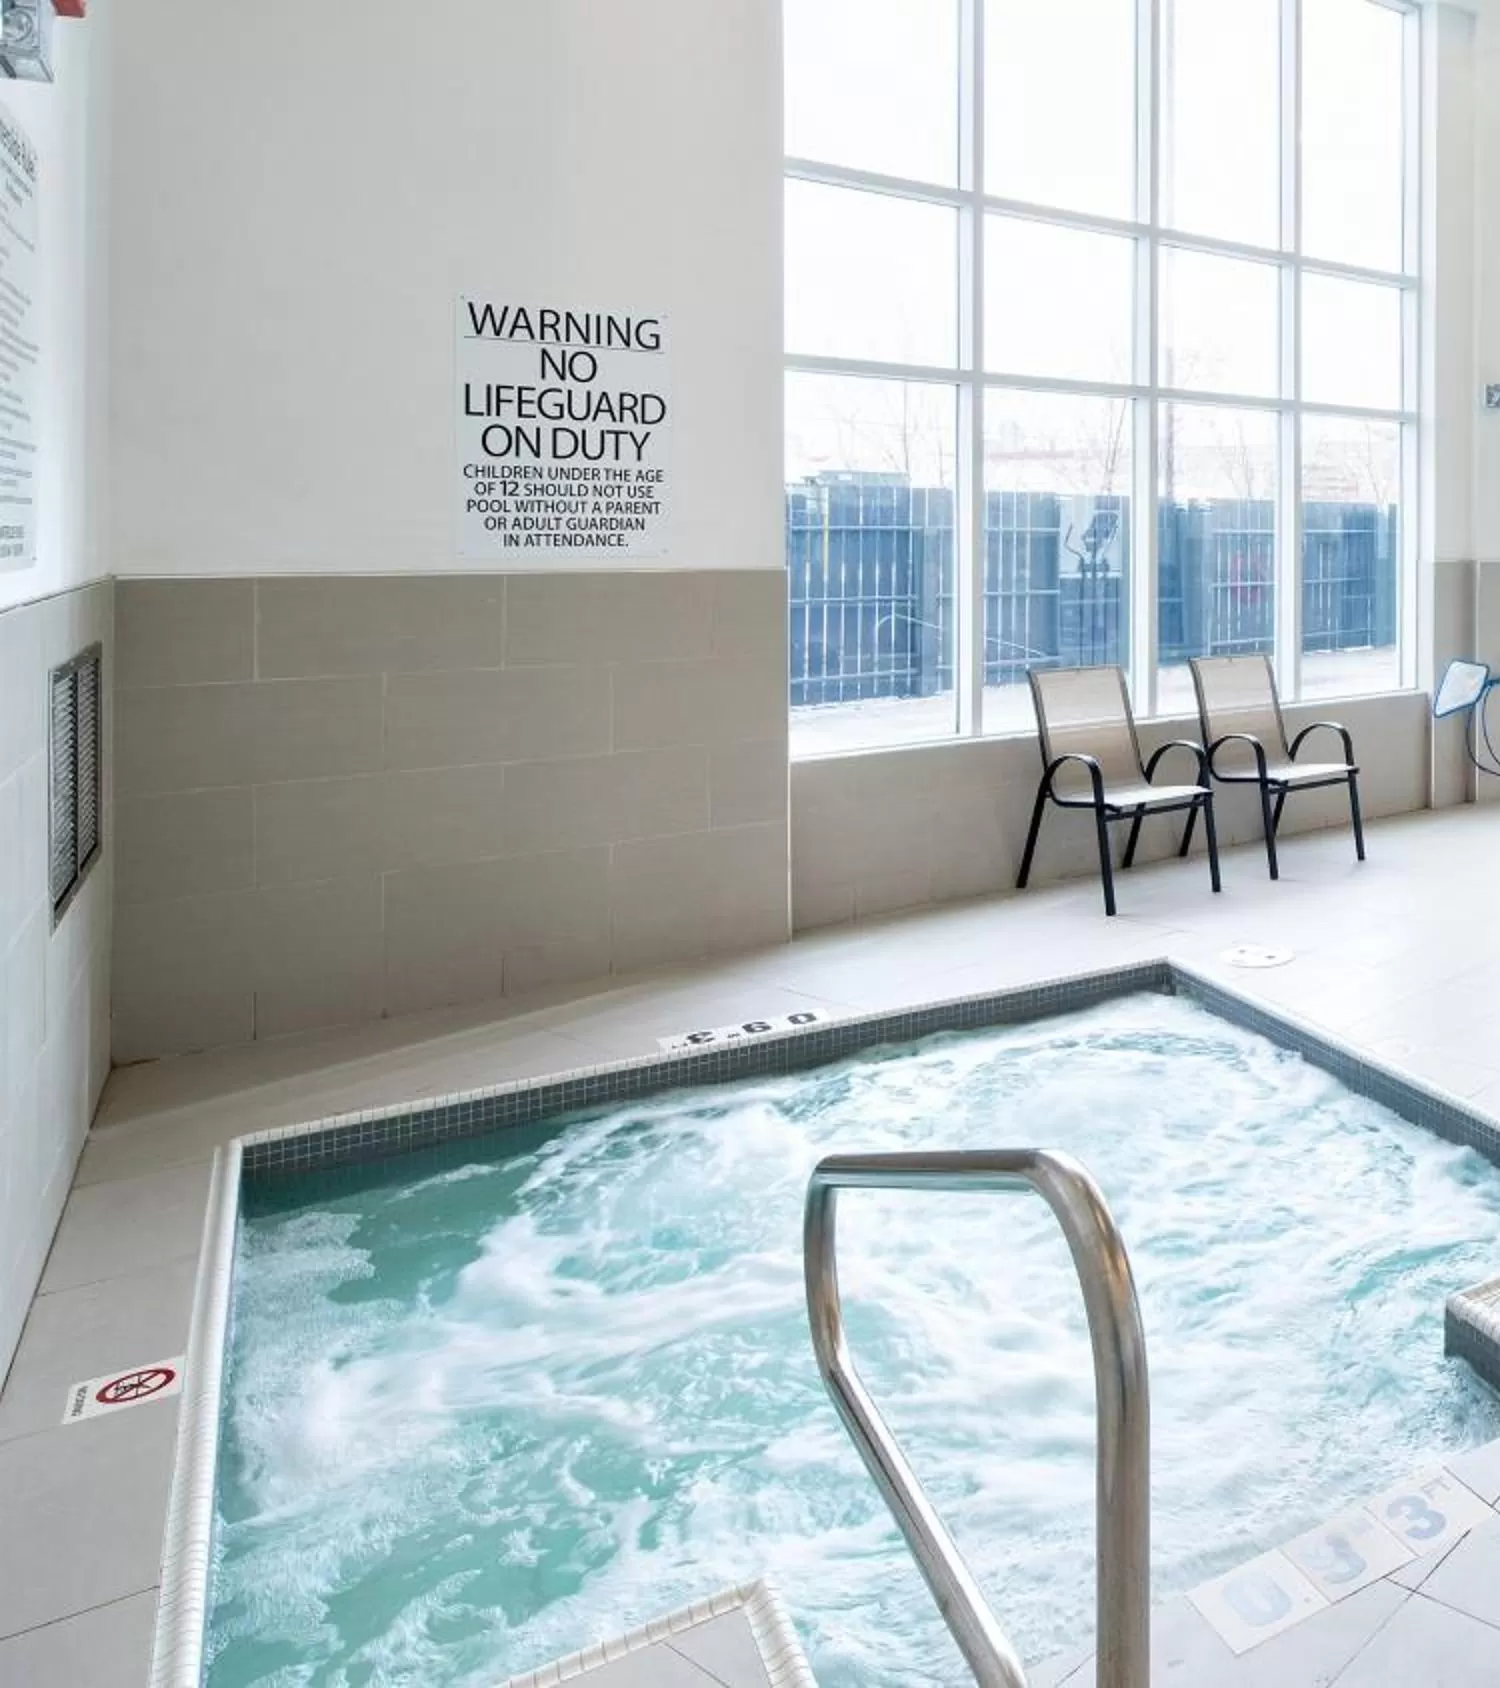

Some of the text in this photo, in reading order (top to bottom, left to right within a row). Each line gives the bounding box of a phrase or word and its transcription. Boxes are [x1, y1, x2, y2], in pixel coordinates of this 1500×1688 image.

[467, 301, 660, 350] WARNING
[540, 348, 597, 383] NO
[465, 383, 666, 425] LIFEGUARD
[481, 424, 651, 461] ON DUTY
[463, 464, 664, 483] CHILDREN UNDER THE AGE
[474, 480, 654, 499] OF 12 SHOULD NOT USE
[466, 499, 661, 515] POOL WITHOUT A PARENT
[484, 516, 645, 531] OR ADULT GUARDIAN
[503, 533, 629, 548] IN ATTENDANCE.
